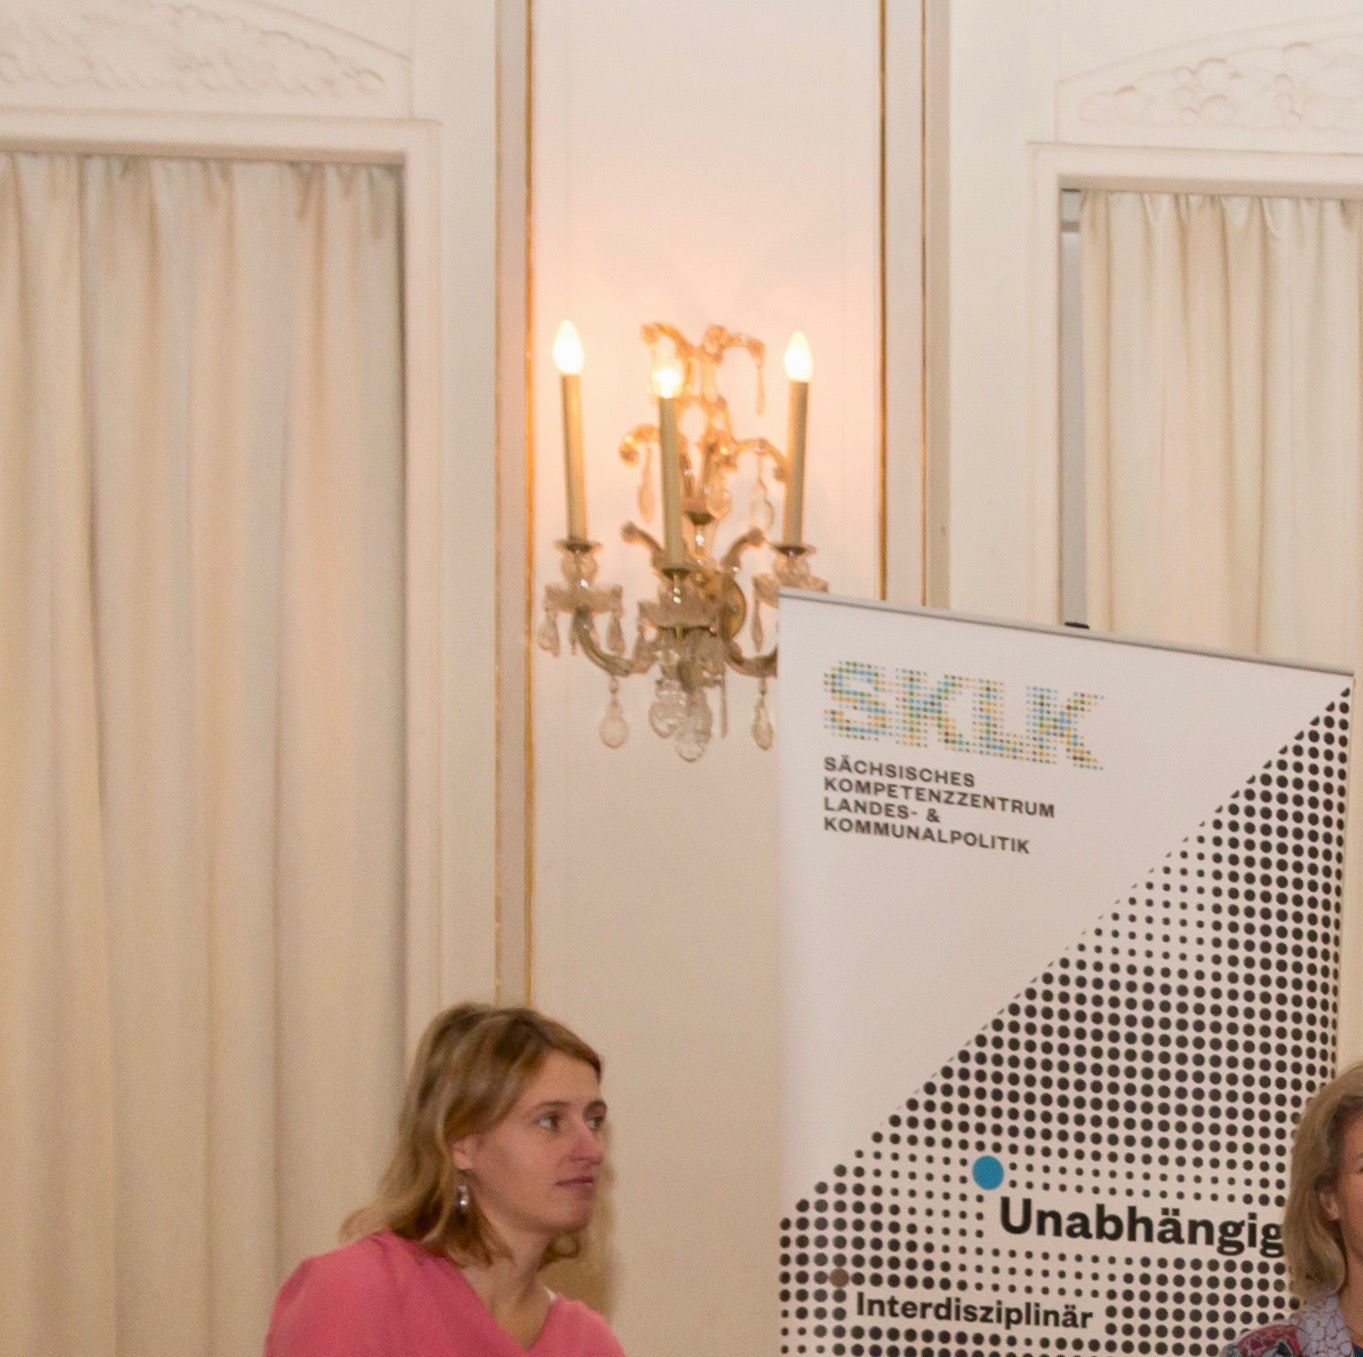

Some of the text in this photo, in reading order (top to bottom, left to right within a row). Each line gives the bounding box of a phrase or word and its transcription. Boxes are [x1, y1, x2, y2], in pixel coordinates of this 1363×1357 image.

[822, 660, 1105, 771] SKLK
[823, 755, 976, 788] SÄCHSISCHES
[823, 776, 1055, 818] KOMPETENZZENTRUM
[823, 797, 940, 823] LANDES- &
[823, 817, 1030, 854] KOMMUNALPOLITIK
[1000, 1196, 1285, 1259] Unabhängig
[856, 1291, 1093, 1331] Interdisziplinär
